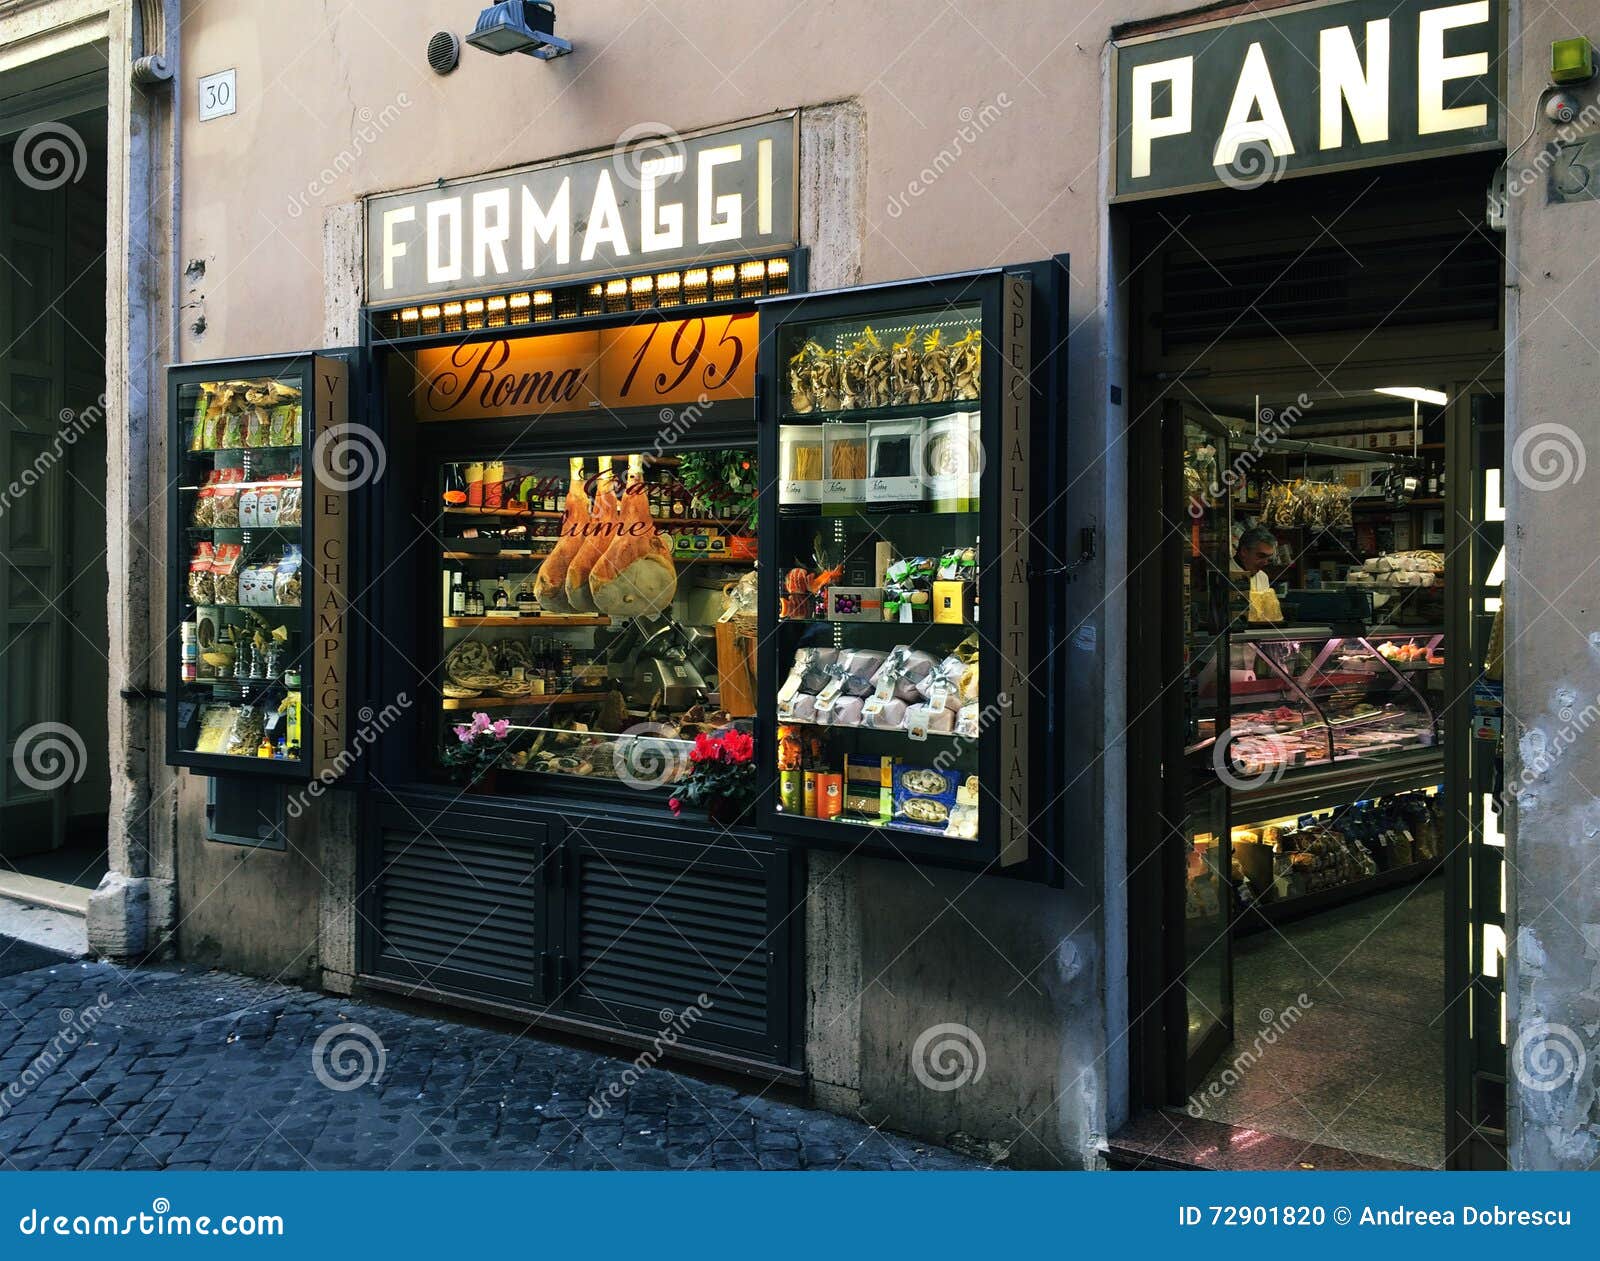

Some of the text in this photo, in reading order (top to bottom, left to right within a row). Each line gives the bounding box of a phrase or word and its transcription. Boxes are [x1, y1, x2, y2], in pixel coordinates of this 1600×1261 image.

[206, 82, 230, 109] 30
[1131, 0, 1489, 179] PANE
[383, 138, 773, 290] FORMAGGI
[427, 311, 759, 412] Roma 195
[319, 375, 343, 760] VINI E CHAMPAGNE
[1008, 601, 1025, 842] ITALIANE
